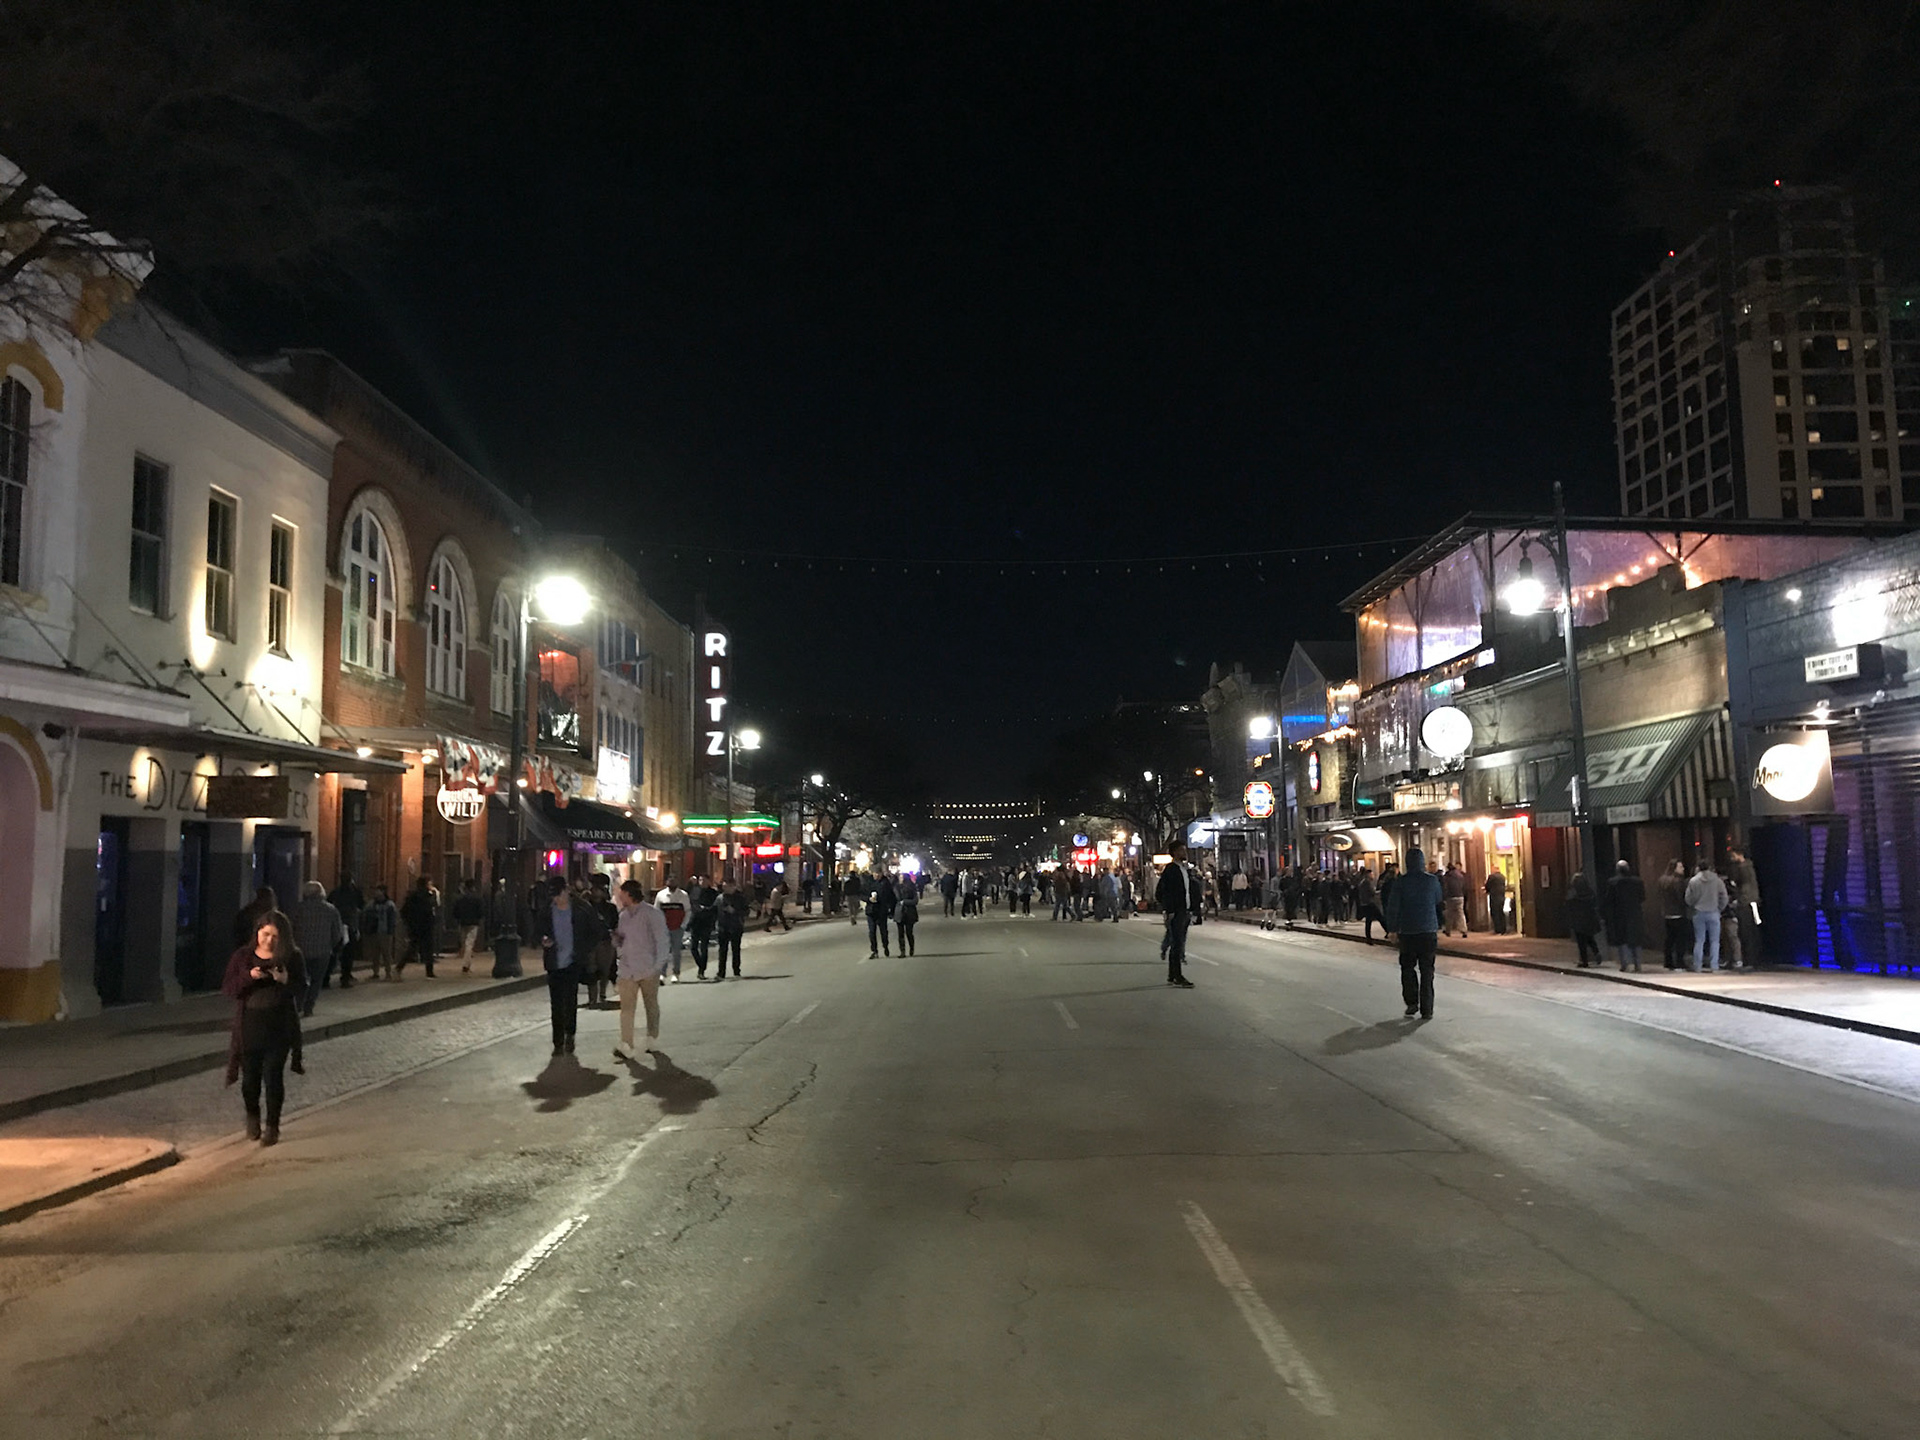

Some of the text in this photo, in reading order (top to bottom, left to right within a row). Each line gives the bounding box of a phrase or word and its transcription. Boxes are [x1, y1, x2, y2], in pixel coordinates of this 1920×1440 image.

[705, 632, 727, 756] RITZ
[100, 771, 137, 799] THE
[144, 756, 208, 813] DIZZ
[443, 802, 479, 818] WILD
[615, 831, 634, 841] PUB
